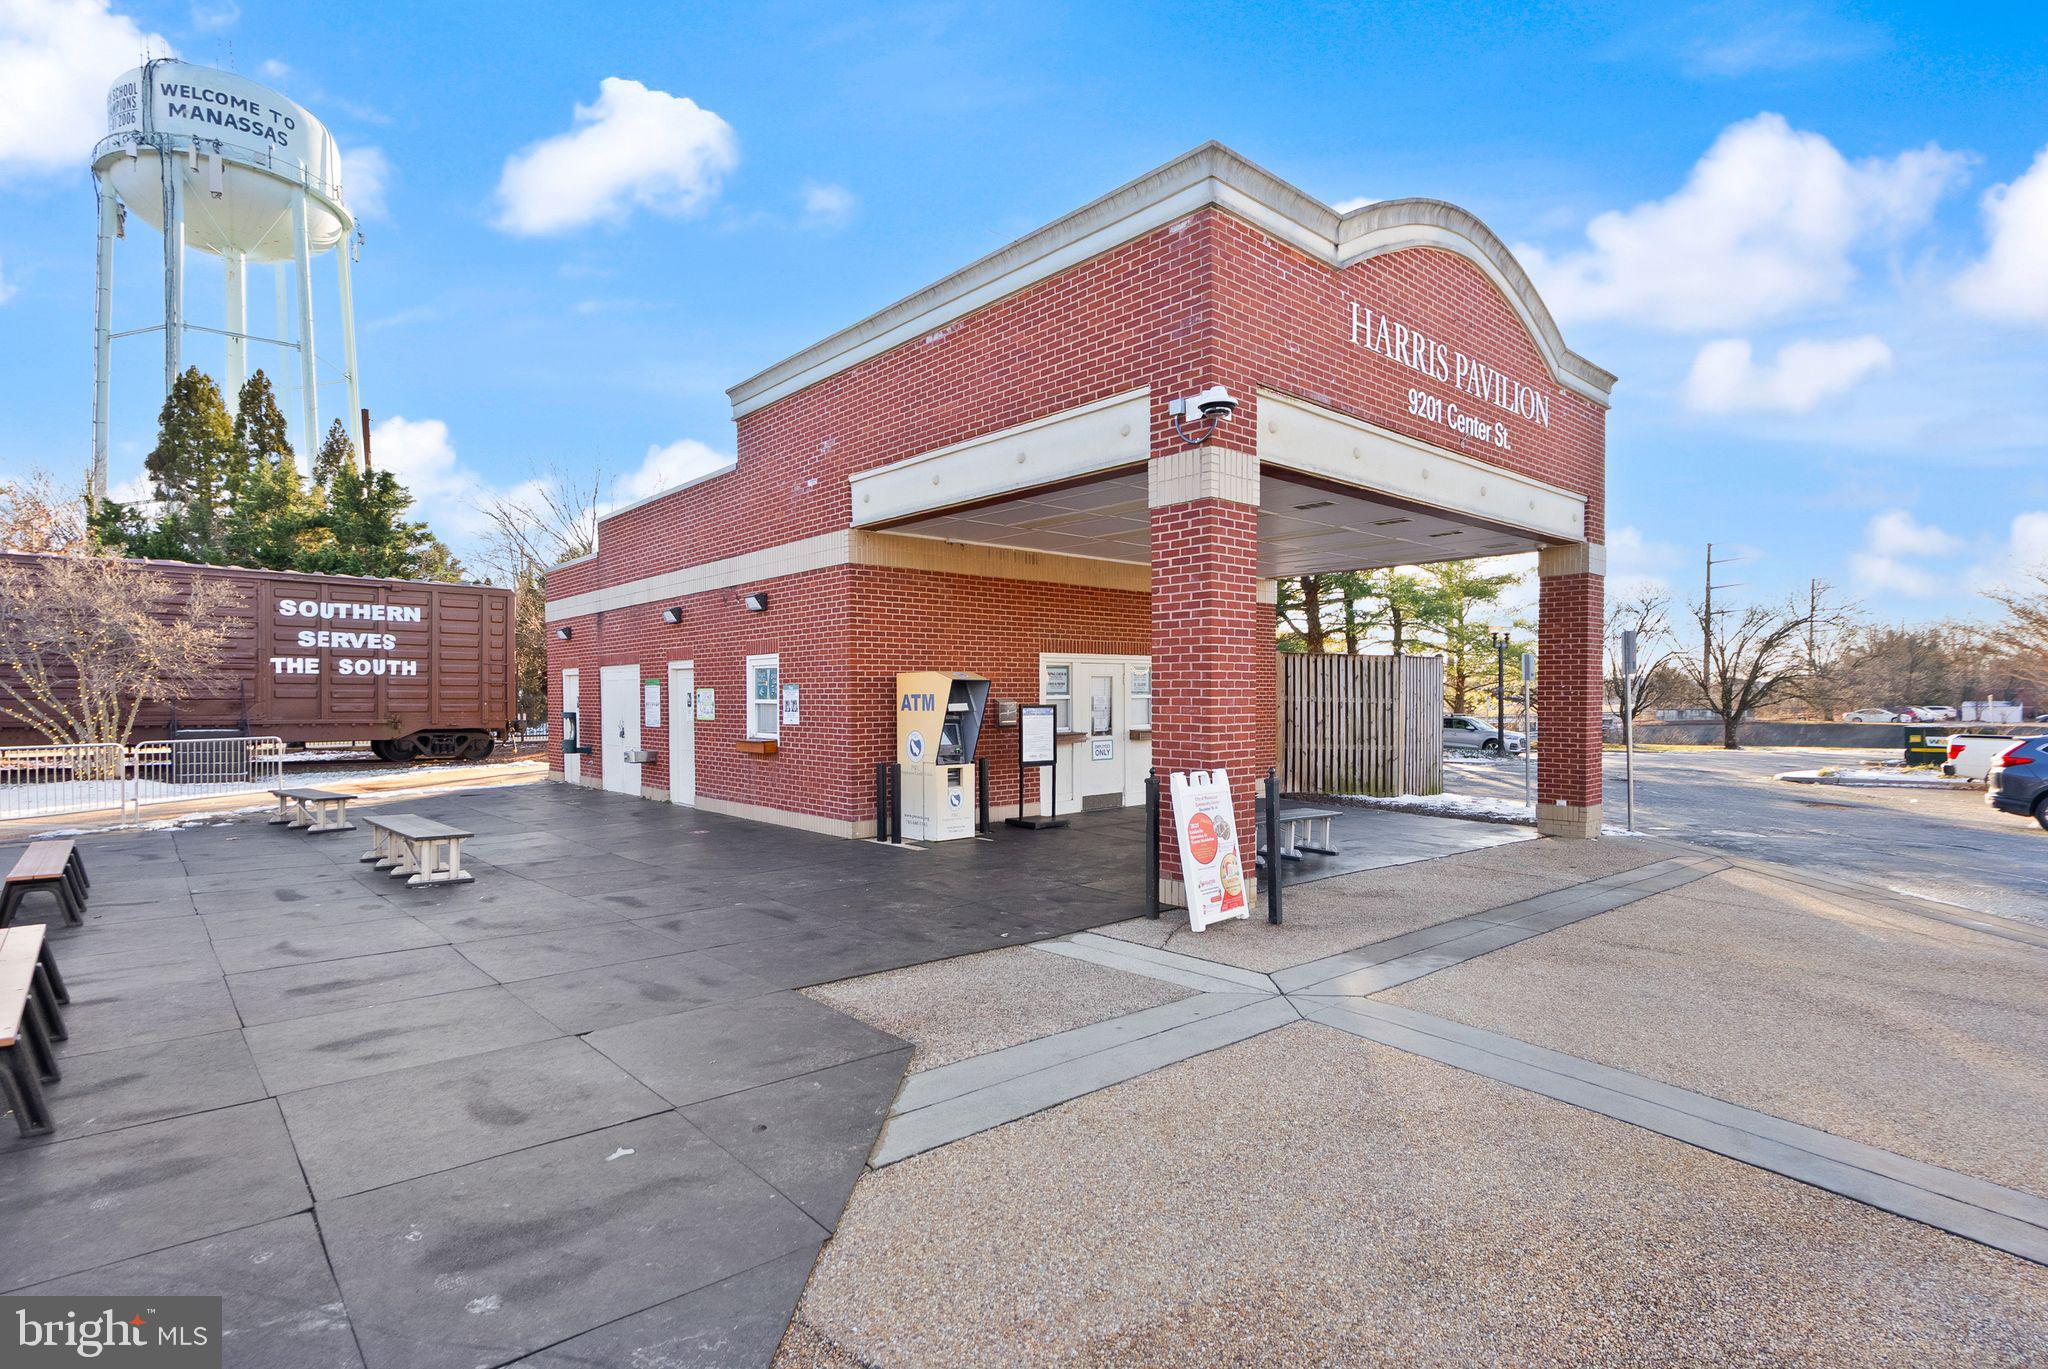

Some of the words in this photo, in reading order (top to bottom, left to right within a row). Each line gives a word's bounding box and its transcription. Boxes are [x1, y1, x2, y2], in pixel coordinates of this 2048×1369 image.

[112, 82, 138, 102] SCHOOL
[161, 83, 260, 116] WELCOME
[269, 109, 296, 130] TO
[119, 112, 136, 127] 2006
[168, 102, 288, 147] MANASSAS
[1349, 301, 1449, 383] HARRIS
[1453, 351, 1549, 428] PAVILION
[1408, 387, 1442, 424] 9201
[1447, 403, 1493, 443] Center
[1494, 421, 1512, 450] St.
[279, 599, 421, 622] SOUTHERN
[298, 631, 397, 651] SERVES
[270, 657, 320, 674] THE
[338, 658, 417, 676] SOUTH
[901, 693, 935, 711] ATM
[1095, 749, 1111, 757] ONLY
